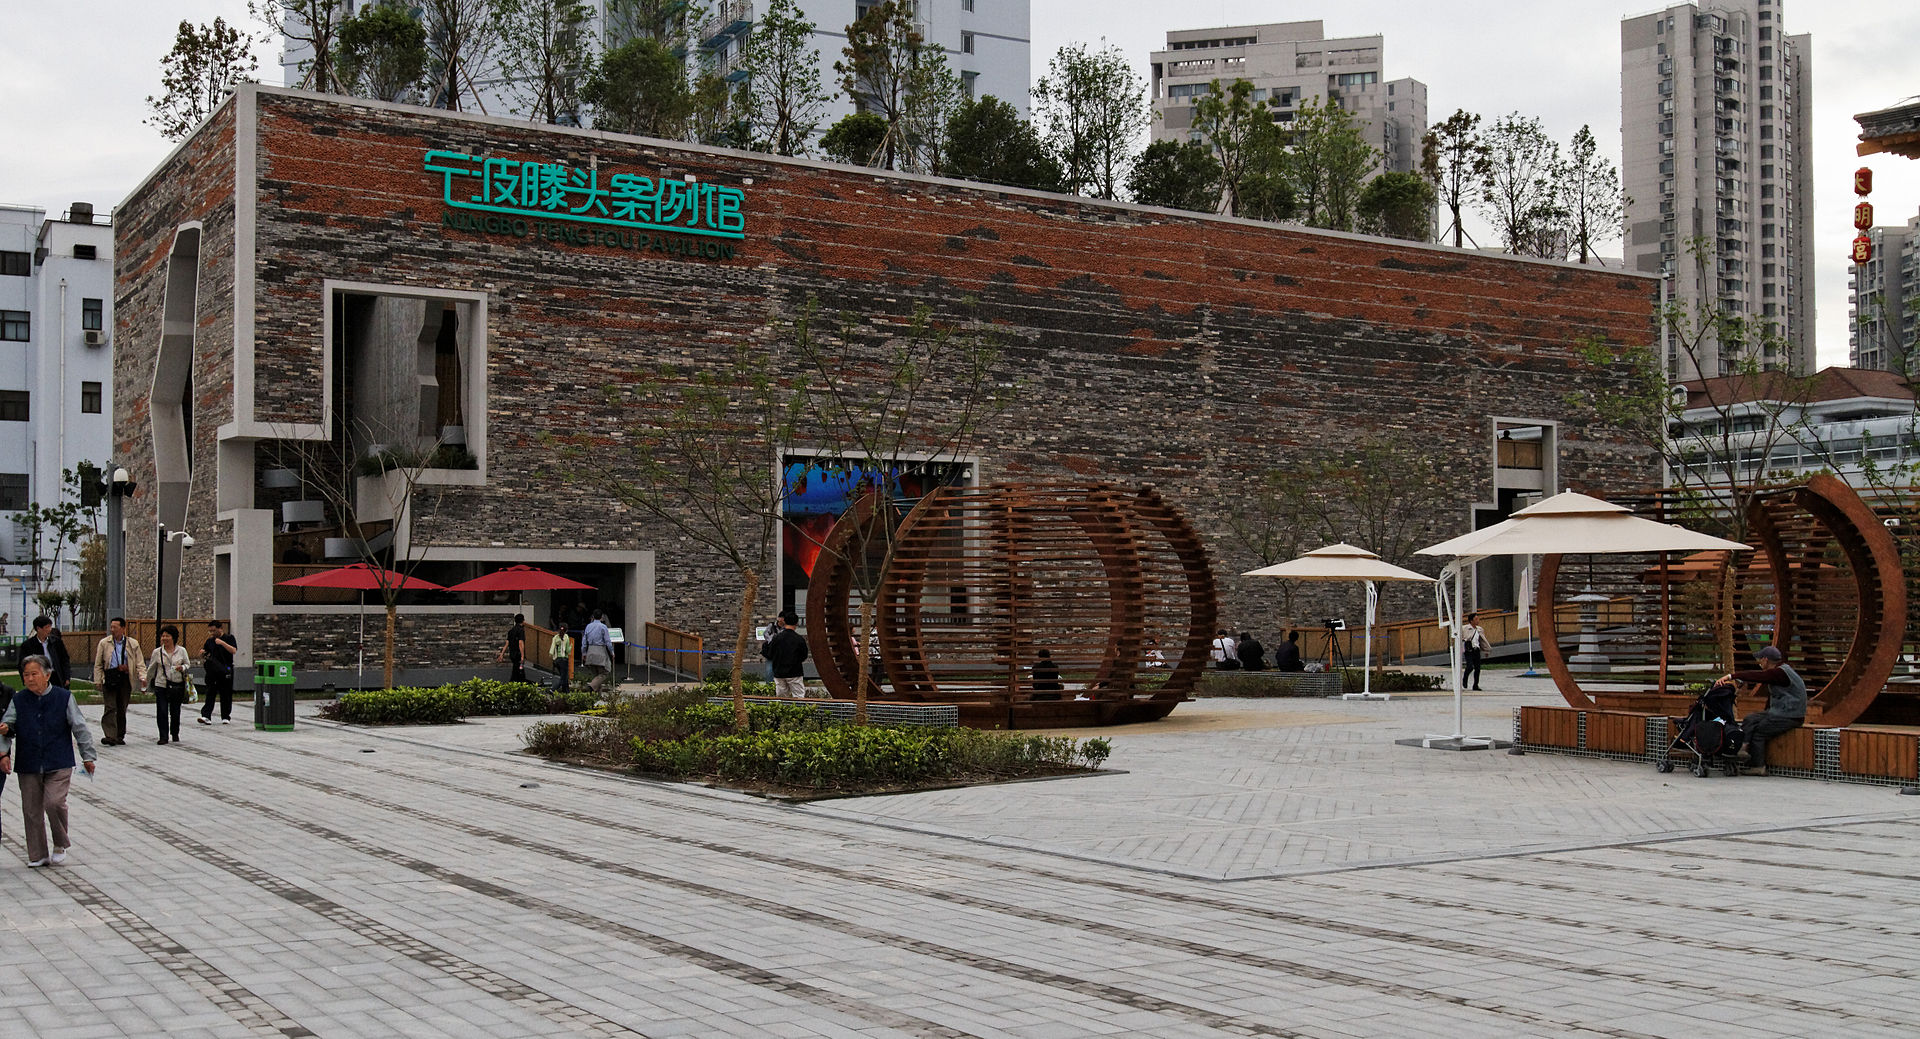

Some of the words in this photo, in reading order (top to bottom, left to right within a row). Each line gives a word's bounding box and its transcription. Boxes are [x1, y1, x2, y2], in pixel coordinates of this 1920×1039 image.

[424, 150, 745, 239] 宁波滕头案例馆
[442, 211, 528, 237] NINGBO
[638, 233, 734, 260] PAVILION
